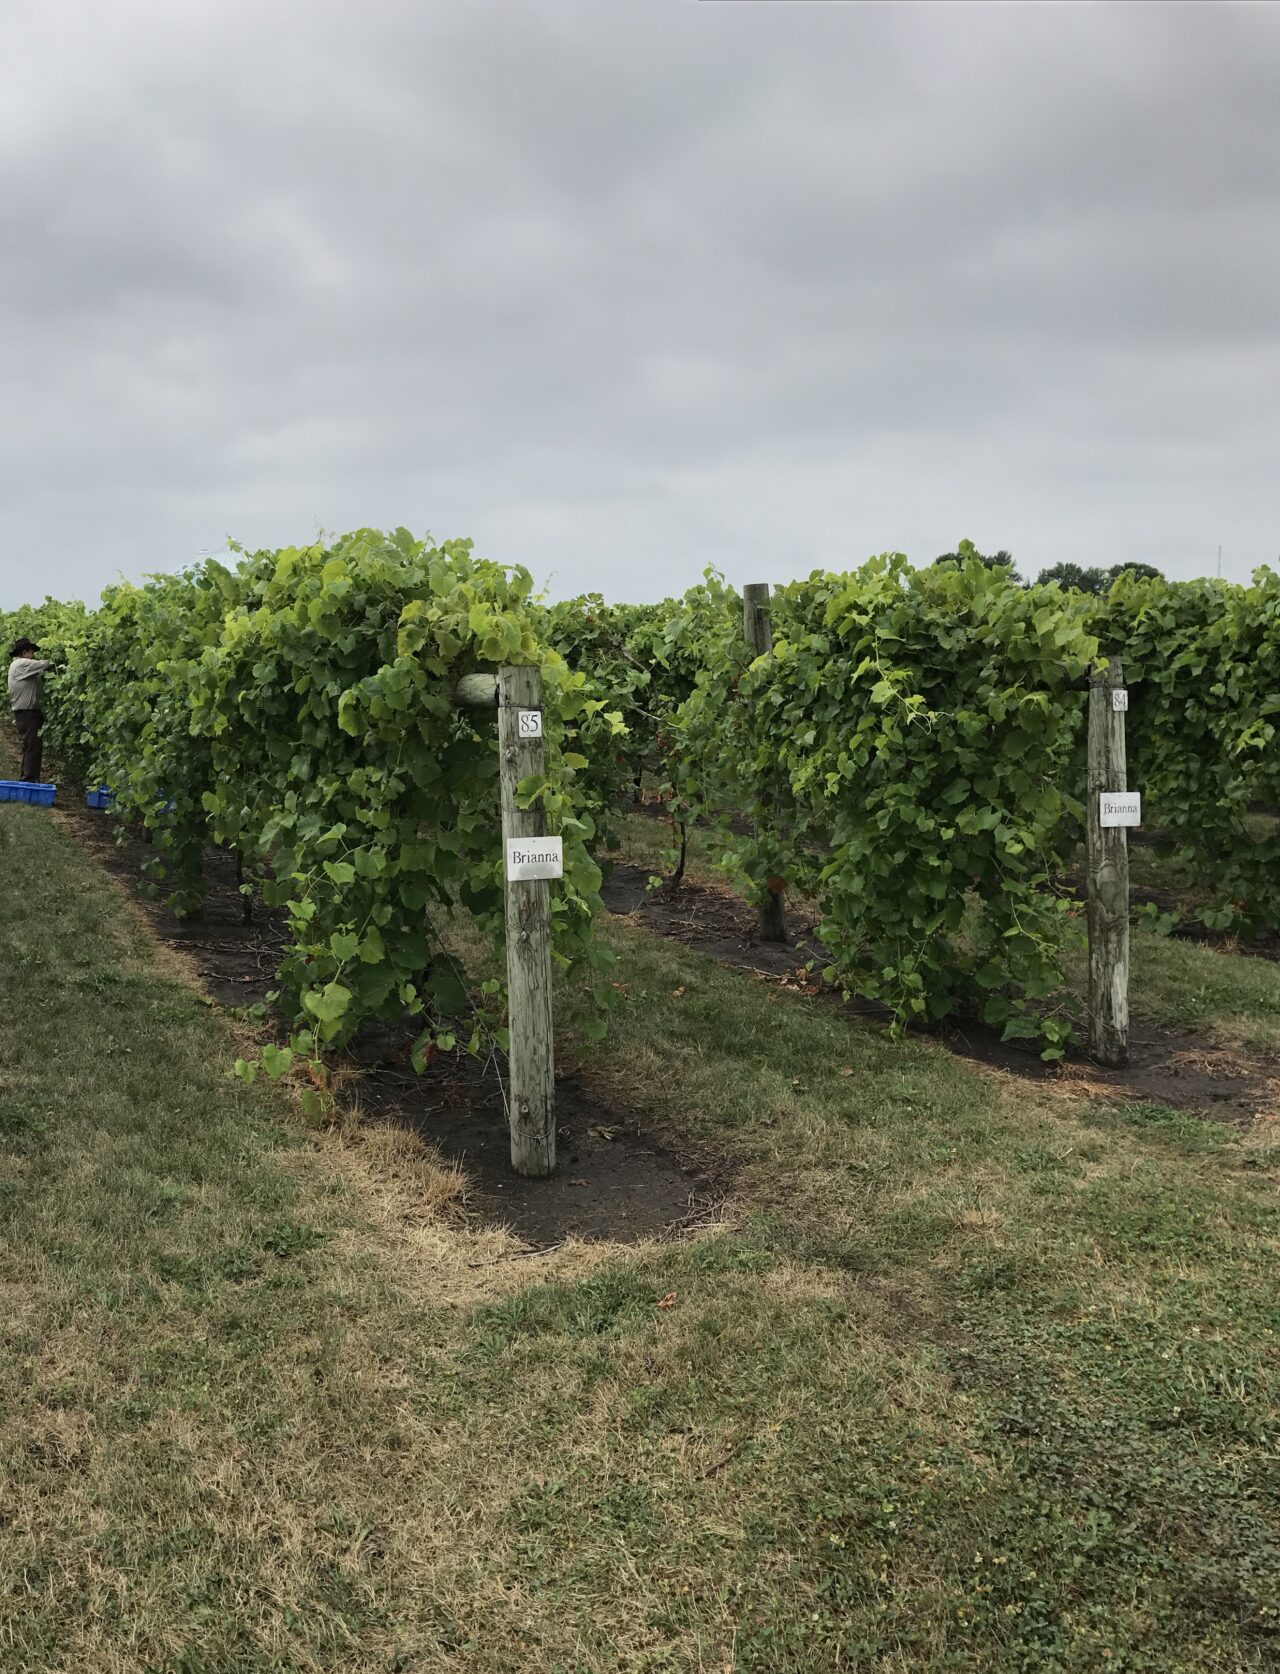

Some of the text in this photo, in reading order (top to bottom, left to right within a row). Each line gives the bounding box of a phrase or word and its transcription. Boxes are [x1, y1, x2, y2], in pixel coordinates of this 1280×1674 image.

[521, 714, 539, 732] 85
[1104, 802, 1138, 814] Brianna
[513, 850, 559, 864] Brianna
